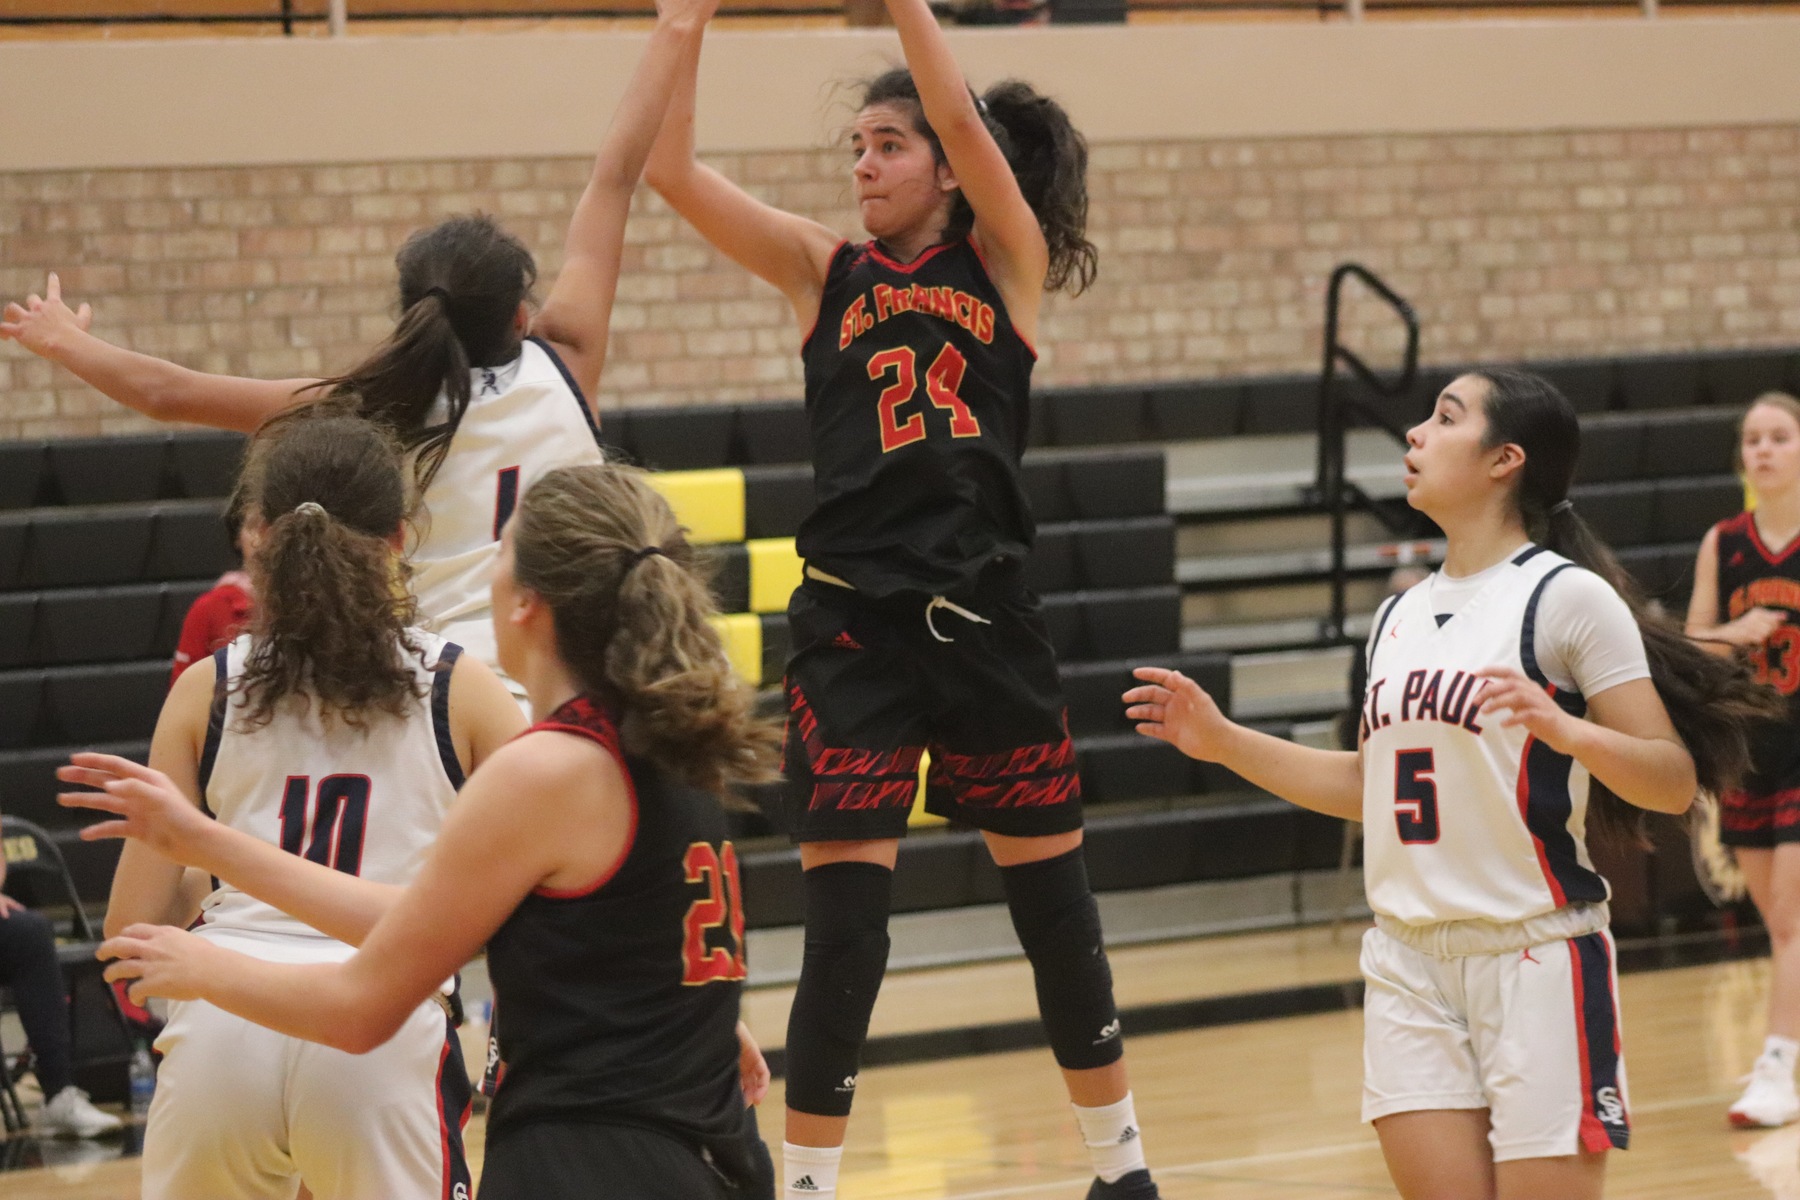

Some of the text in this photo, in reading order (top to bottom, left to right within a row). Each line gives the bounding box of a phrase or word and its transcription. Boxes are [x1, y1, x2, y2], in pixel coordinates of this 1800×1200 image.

[839, 282, 995, 350] ST. FRANCIS
[867, 341, 981, 453] 24
[1401, 669, 1484, 736] PAUL
[278, 772, 372, 878] 10
[1394, 747, 1441, 845] 5
[681, 840, 748, 986] 21
